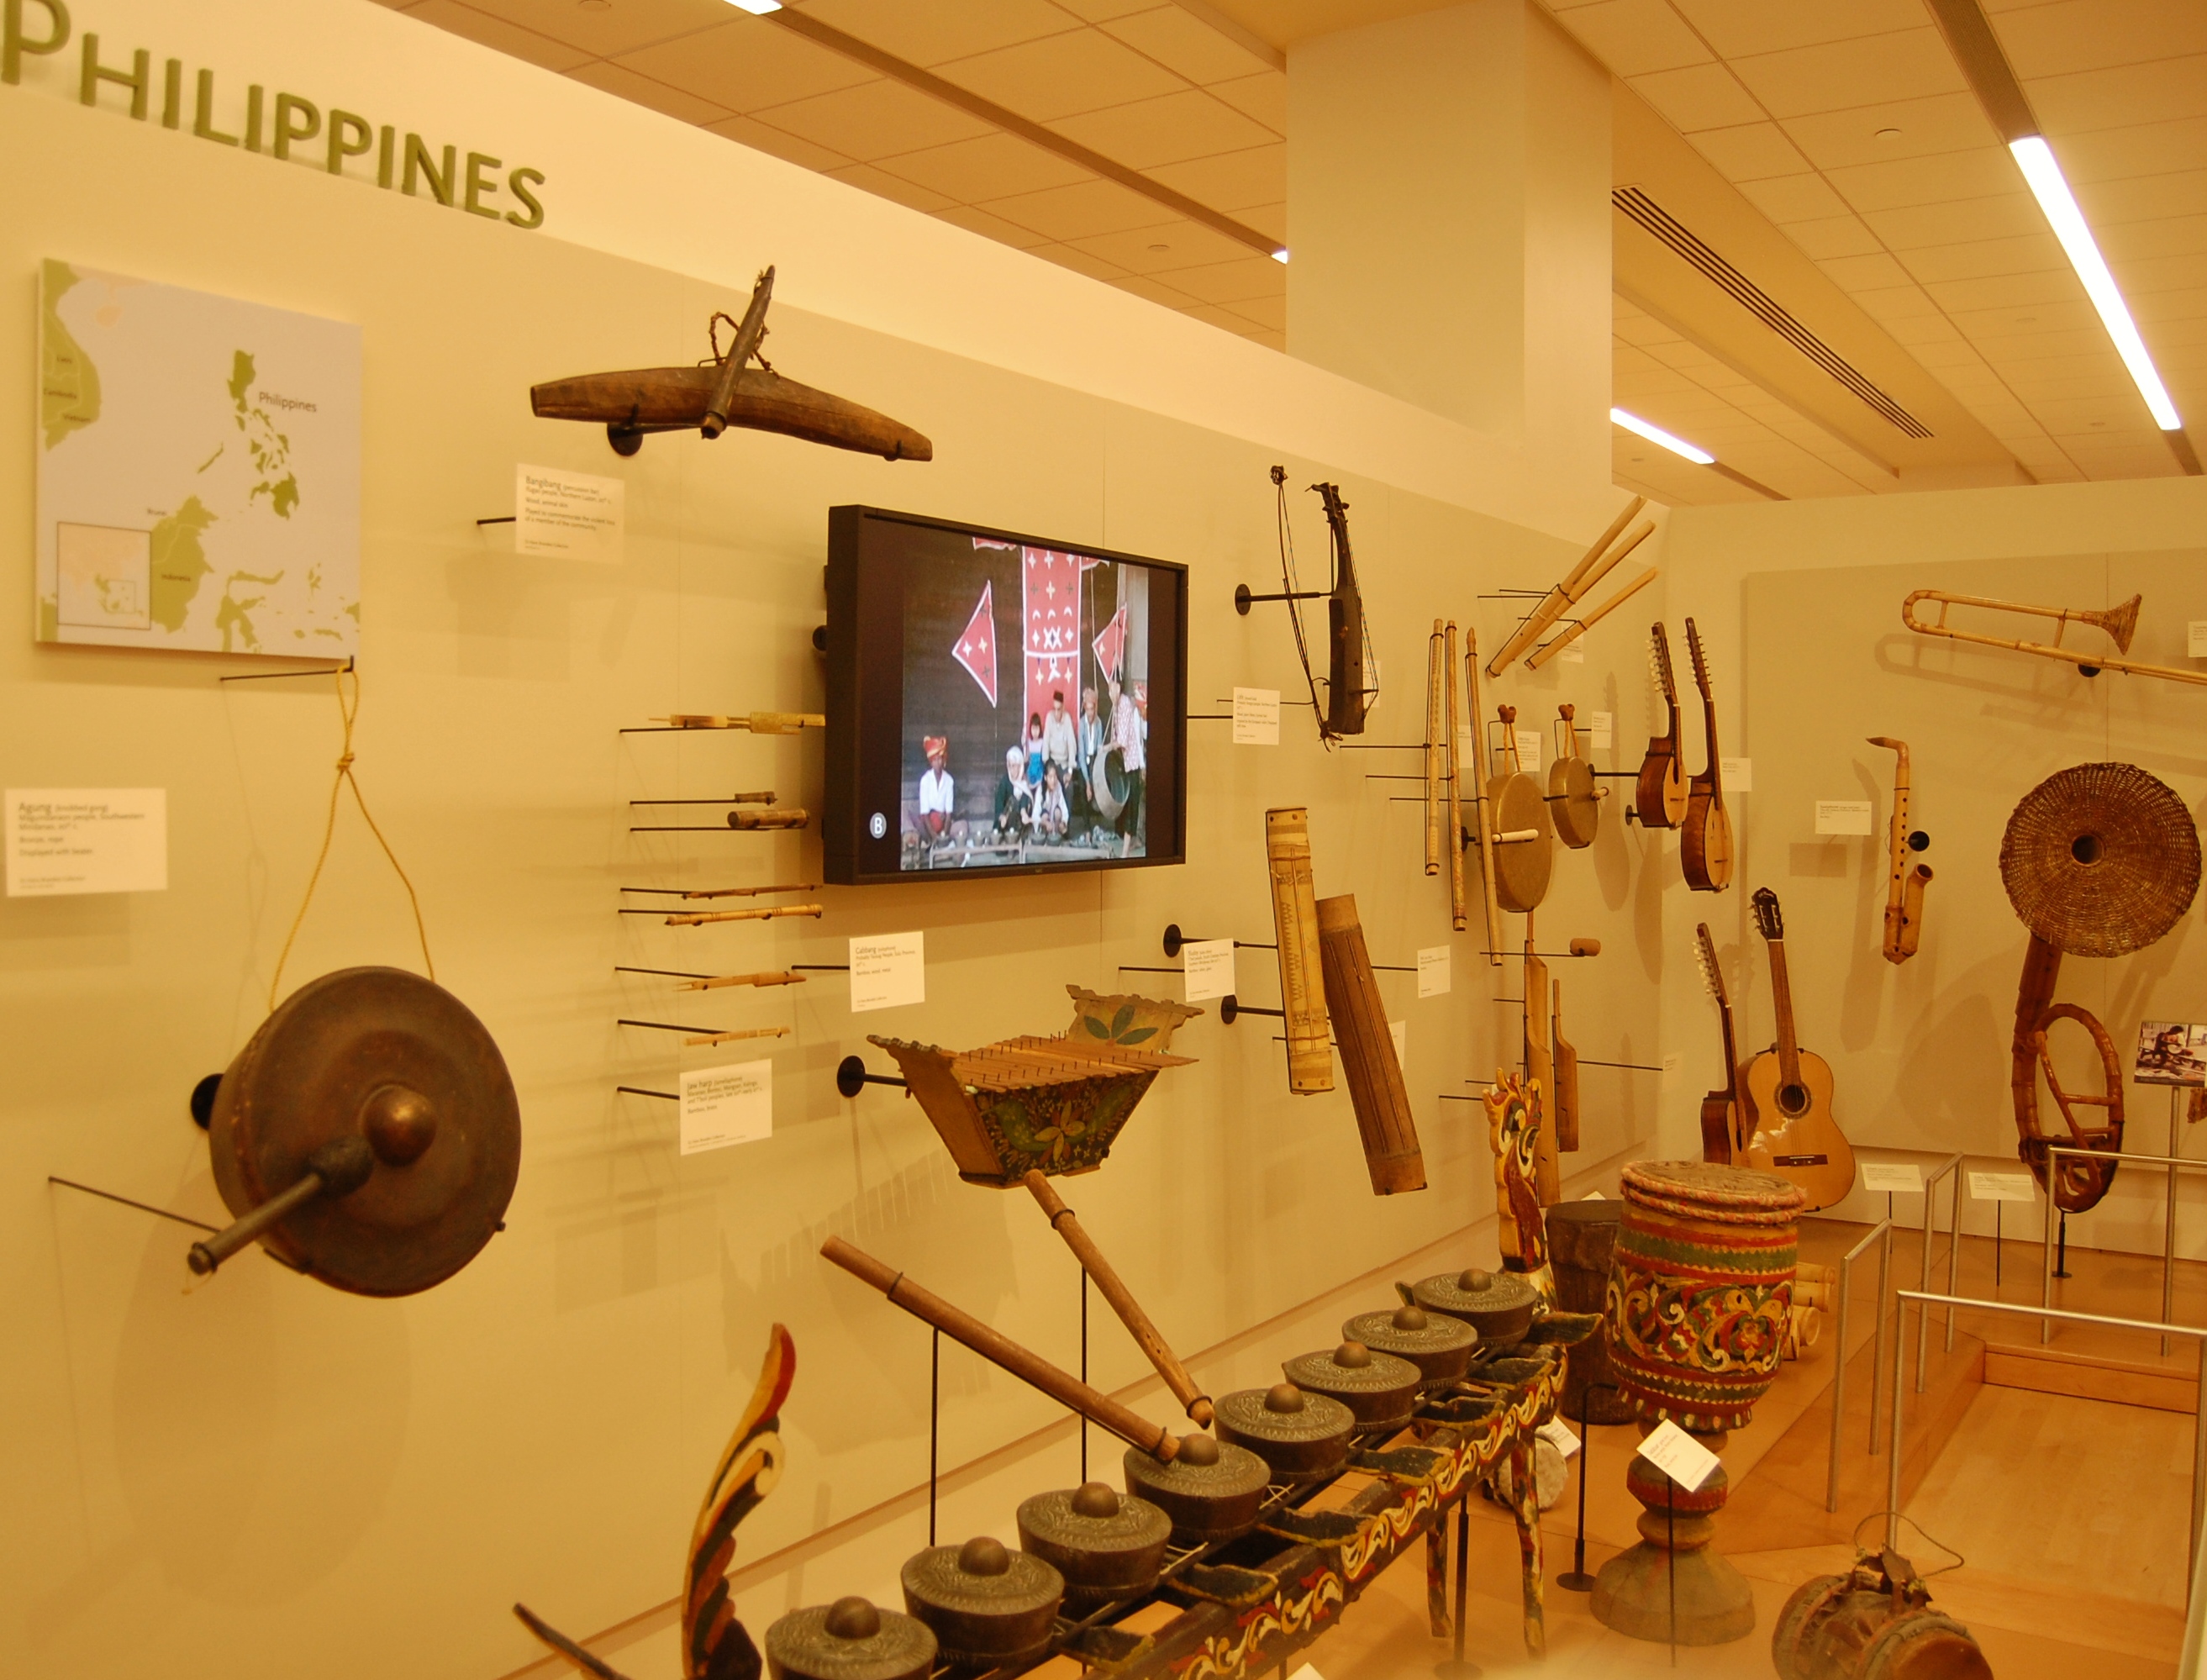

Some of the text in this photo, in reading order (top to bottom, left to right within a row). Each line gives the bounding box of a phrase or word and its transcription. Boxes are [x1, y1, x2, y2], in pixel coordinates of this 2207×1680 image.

[1, 0, 545, 229] PHILIPPINES
[259, 391, 318, 413] Philippines
[874, 817, 882, 835] B
